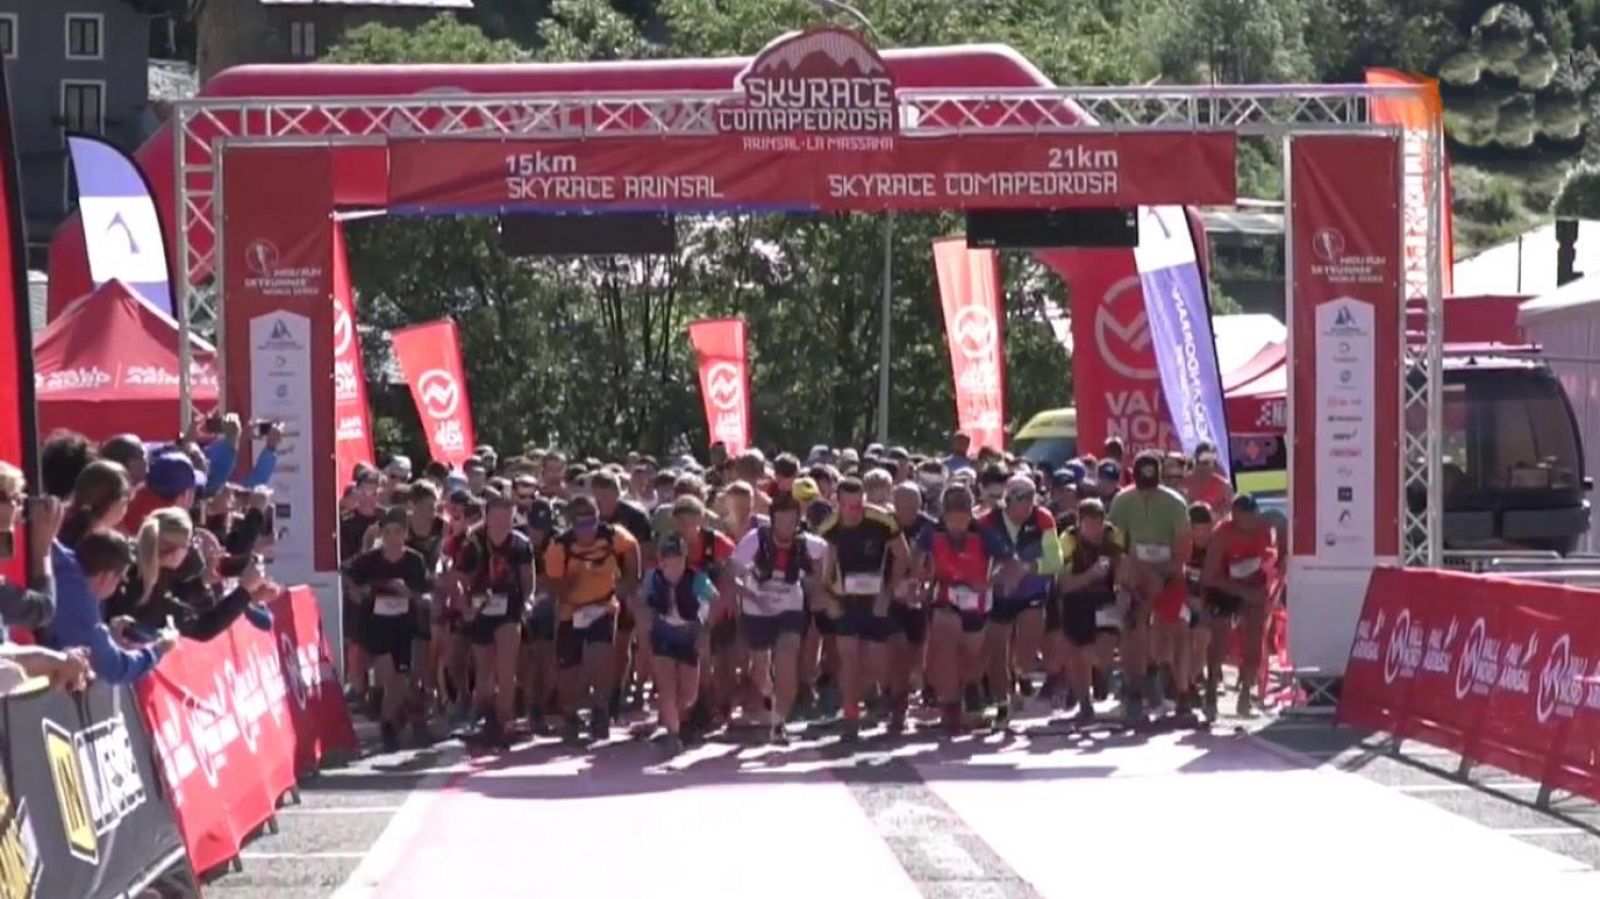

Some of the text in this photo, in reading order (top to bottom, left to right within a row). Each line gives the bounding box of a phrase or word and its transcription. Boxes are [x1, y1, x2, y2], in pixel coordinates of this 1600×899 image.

[745, 77, 892, 108] SKYRACE
[718, 108, 893, 131] COMAPEDROSA
[505, 150, 577, 175] 15km
[1048, 145, 1118, 168] 21km
[505, 175, 724, 199] SKYRACE ARINSAL
[828, 171, 1118, 197] SKYRACE COMAPEDROSA
[1105, 390, 1160, 416] VA
